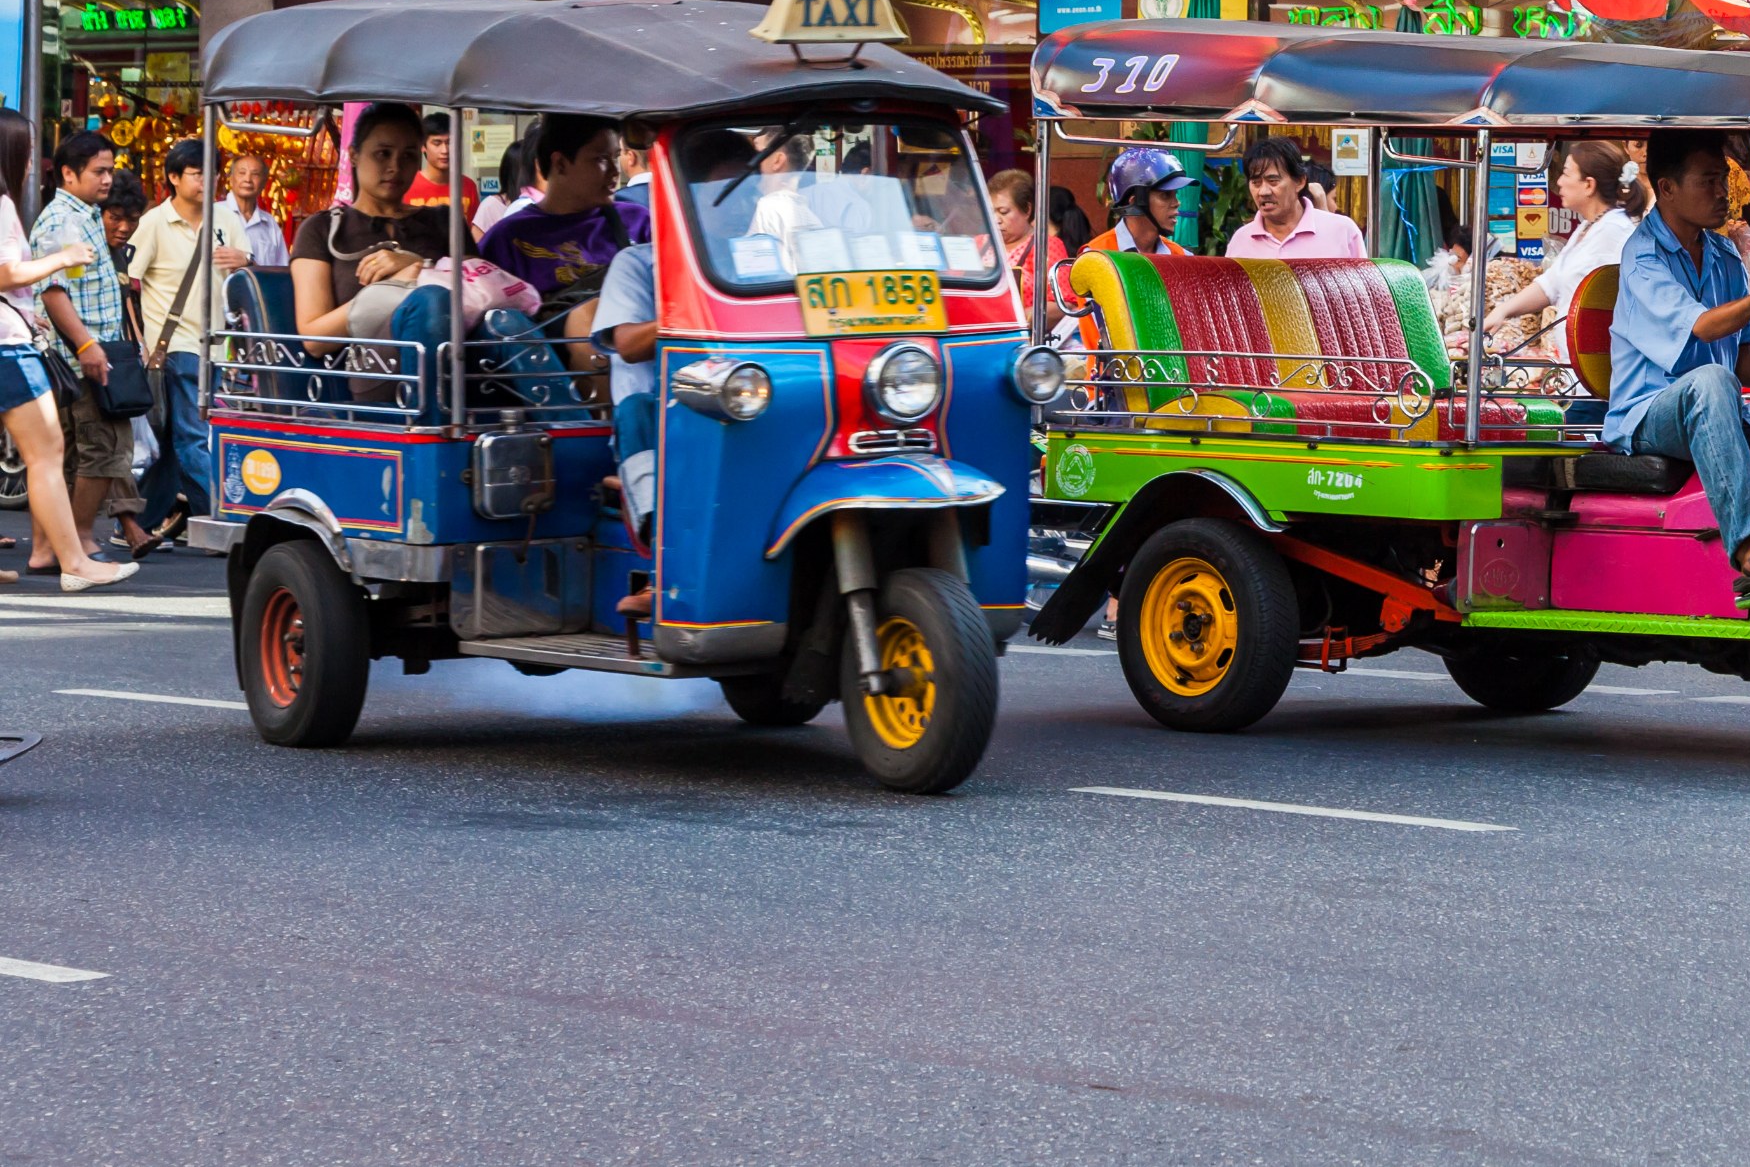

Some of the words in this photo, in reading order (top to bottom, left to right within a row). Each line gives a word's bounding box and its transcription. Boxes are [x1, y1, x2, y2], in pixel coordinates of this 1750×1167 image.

[1492, 145, 1514, 155] VISA
[482, 179, 499, 189] VISA
[1520, 246, 1544, 256] VISA
[866, 275, 935, 305] 1858
